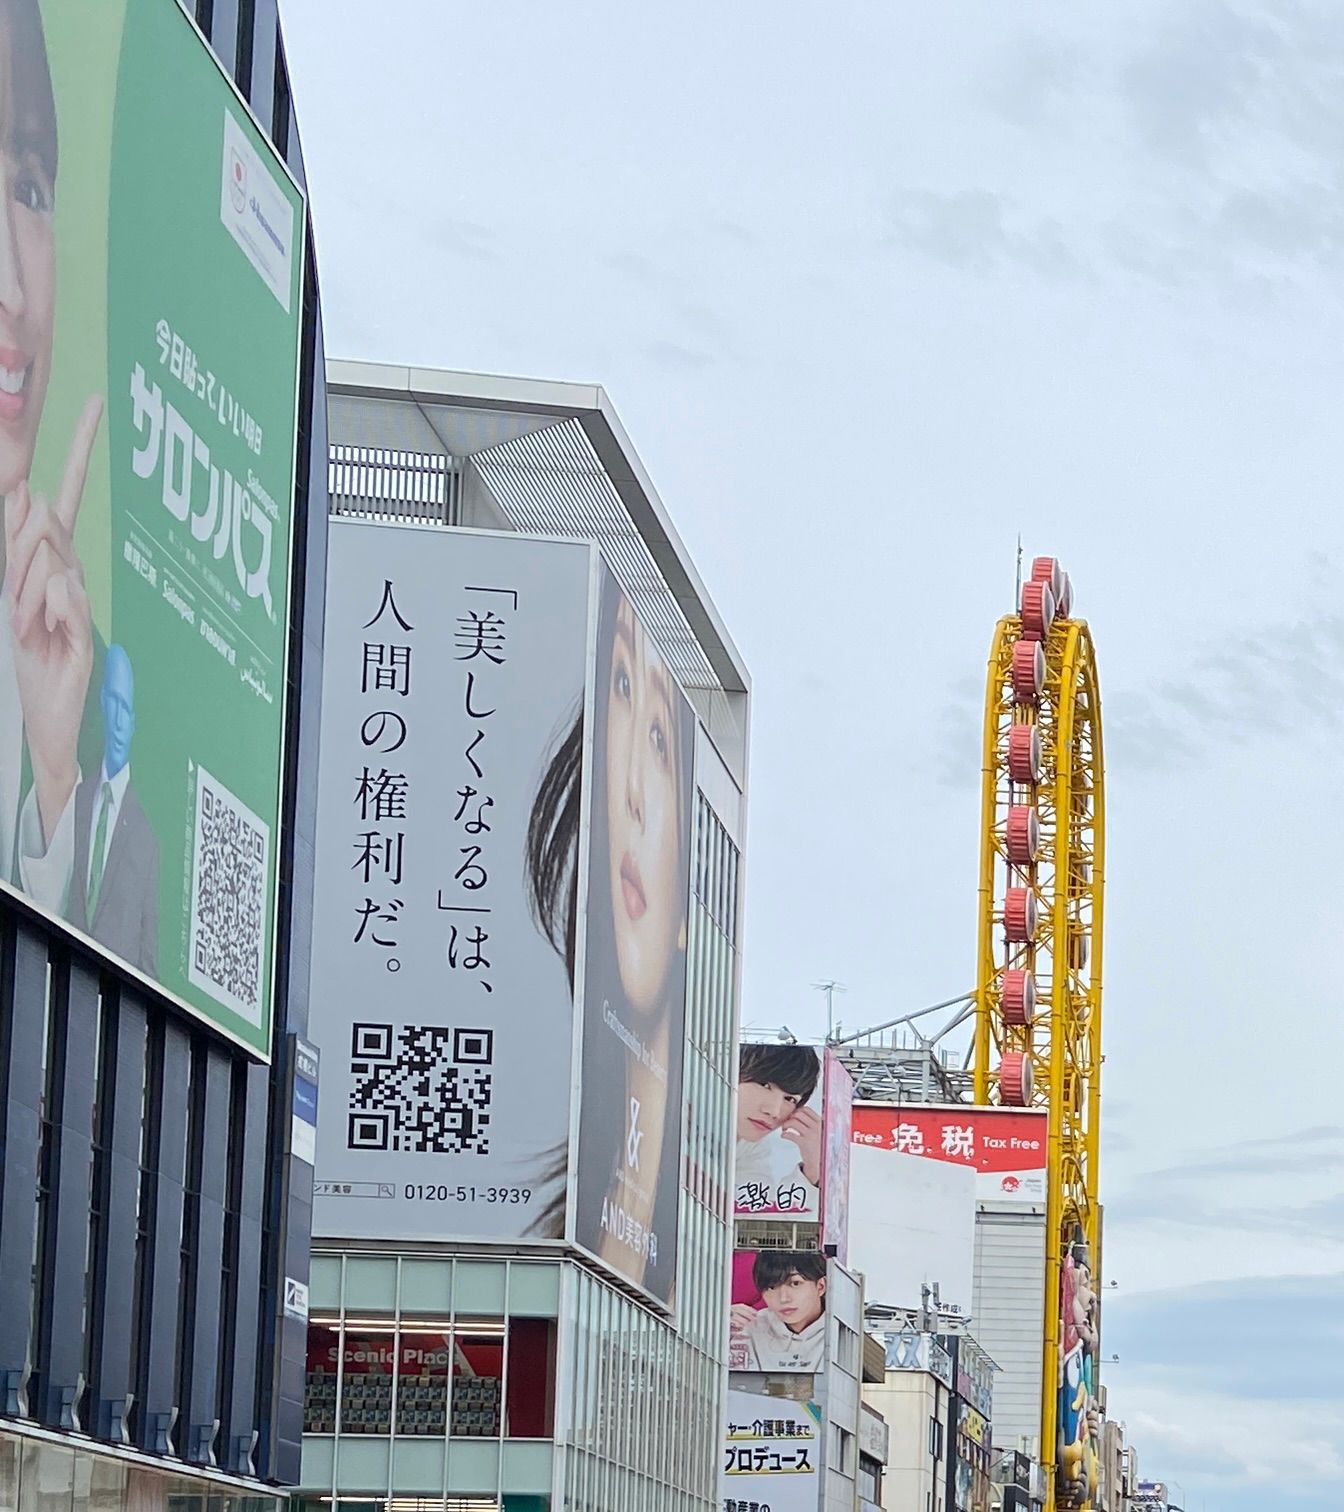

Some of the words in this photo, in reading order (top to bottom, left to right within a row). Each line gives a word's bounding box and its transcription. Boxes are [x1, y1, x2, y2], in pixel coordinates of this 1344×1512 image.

[130, 360, 272, 622] サロンパス
[350, 579, 415, 974] 人間の権利だ。
[437, 585, 518, 993] 「美しくなる」は、
[404, 1184, 532, 1205] 0120-51-3939
[890, 1122, 975, 1156] 免税
[983, 1136, 1007, 1149] Tax
[1011, 1137, 1041, 1150] Free
[725, 1446, 811, 1472] プロデュース
